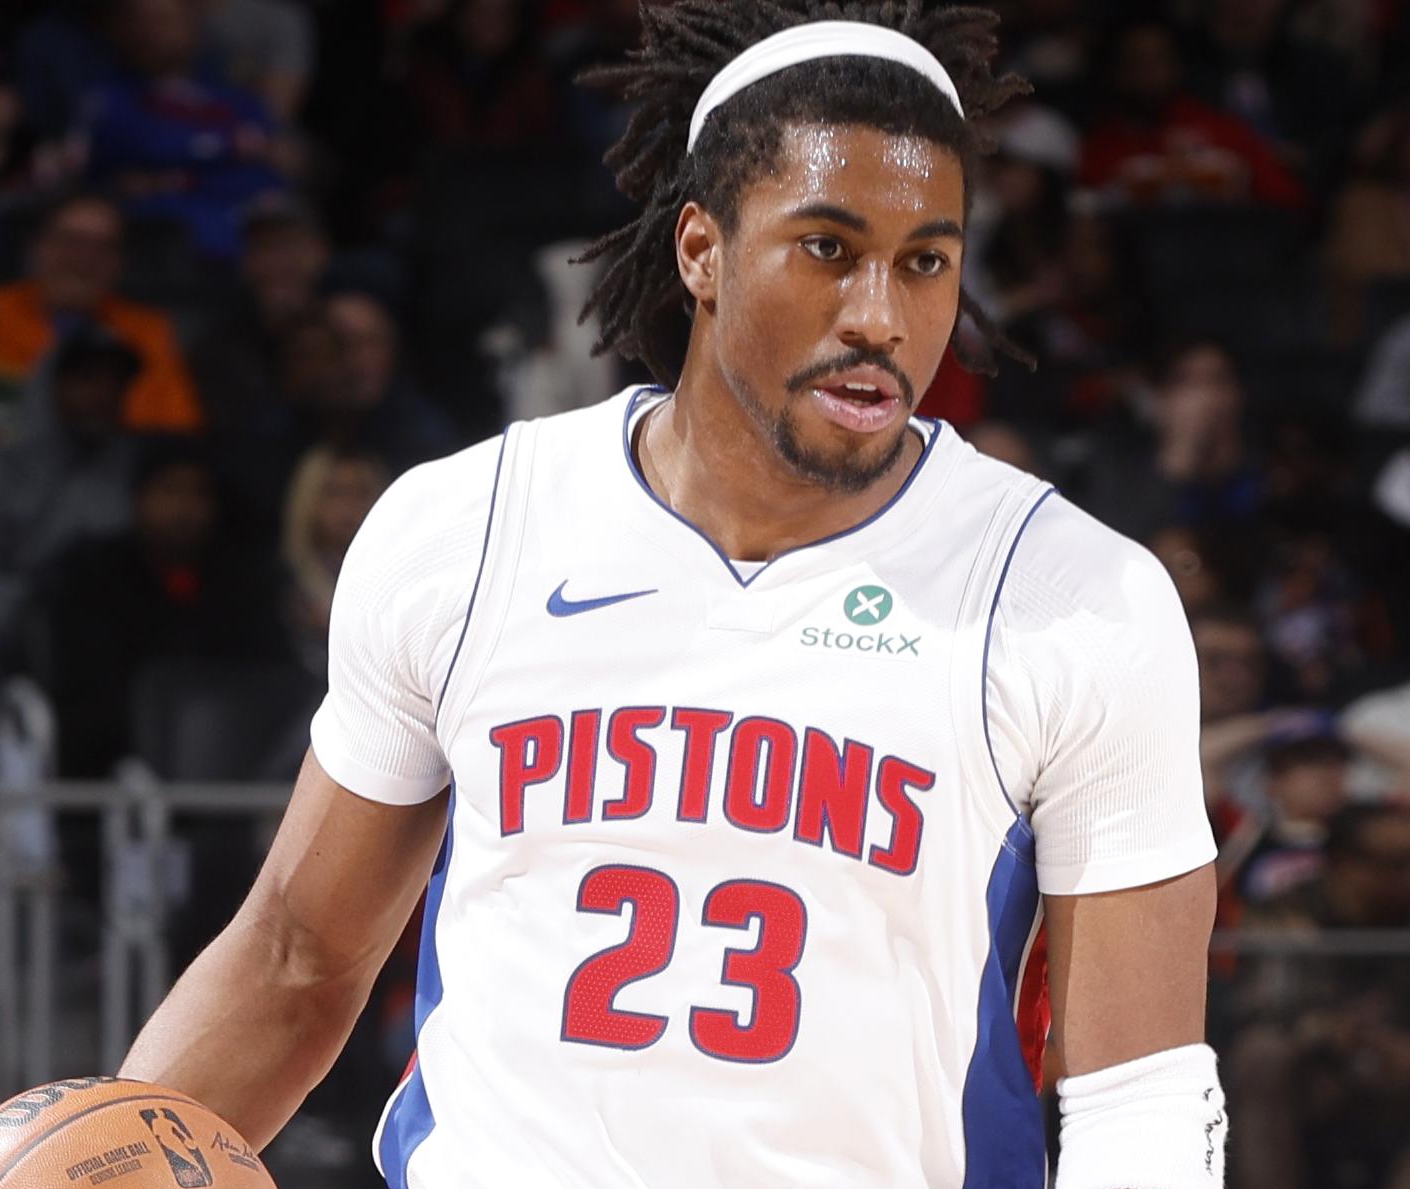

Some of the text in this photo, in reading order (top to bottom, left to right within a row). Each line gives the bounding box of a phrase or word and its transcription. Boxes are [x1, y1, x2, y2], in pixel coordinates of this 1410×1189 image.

[799, 626, 922, 657] StockX
[489, 706, 936, 877] PISTONS
[560, 864, 808, 1064] 23
[66, 1140, 151, 1181] OFFICIAL GAME BALL
